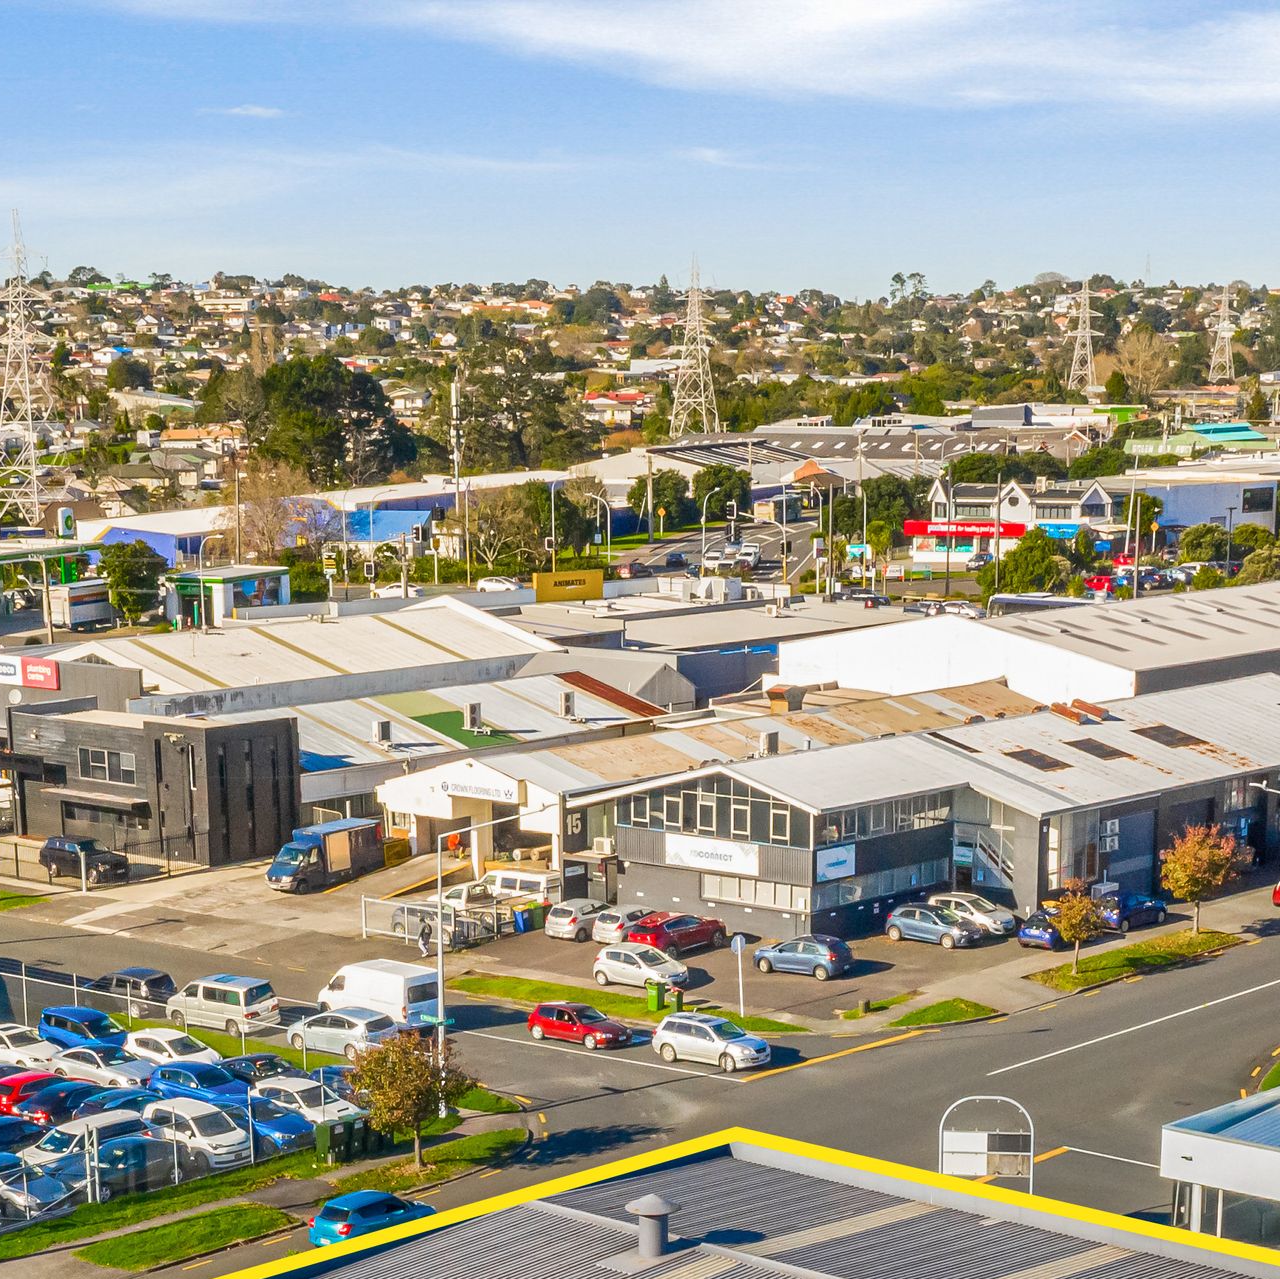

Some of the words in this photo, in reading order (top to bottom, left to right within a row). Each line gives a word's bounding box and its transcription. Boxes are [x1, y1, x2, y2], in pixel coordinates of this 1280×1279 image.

[552, 578, 587, 588] ANIMATES
[27, 664, 52, 675] plumbing
[450, 783, 469, 794] CROWN
[468, 785, 493, 797] FLOORING
[493, 788, 501, 798] LTD
[565, 813, 582, 835] 15
